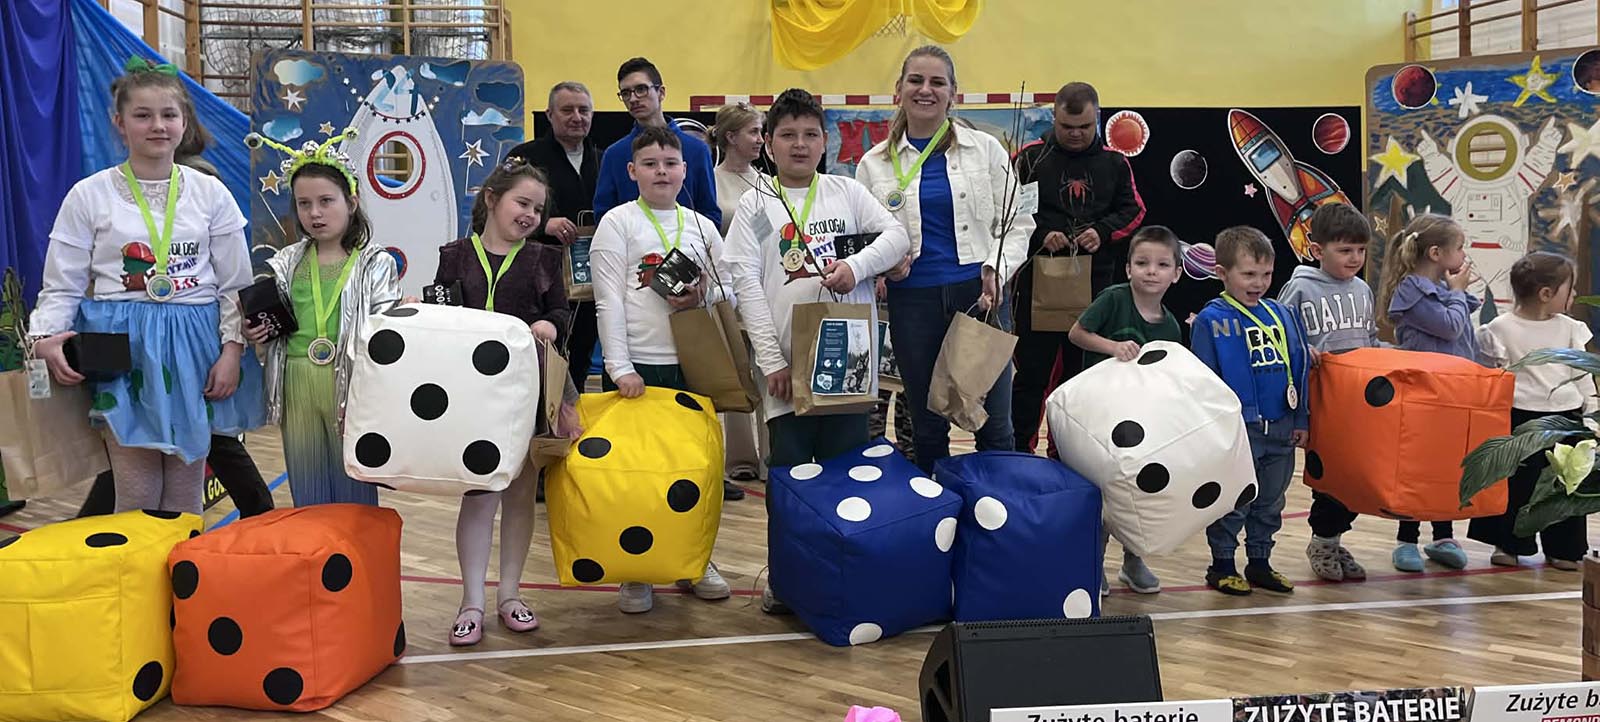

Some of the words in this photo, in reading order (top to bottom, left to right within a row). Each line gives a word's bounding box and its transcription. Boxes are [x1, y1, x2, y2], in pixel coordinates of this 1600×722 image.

[808, 218, 846, 236] EKOLOGIA
[1244, 699, 1348, 722] ZUŻYTE
[1354, 696, 1461, 722] BATERIE
[1505, 692, 1579, 716] Zużyte
[1585, 688, 1600, 708] b
